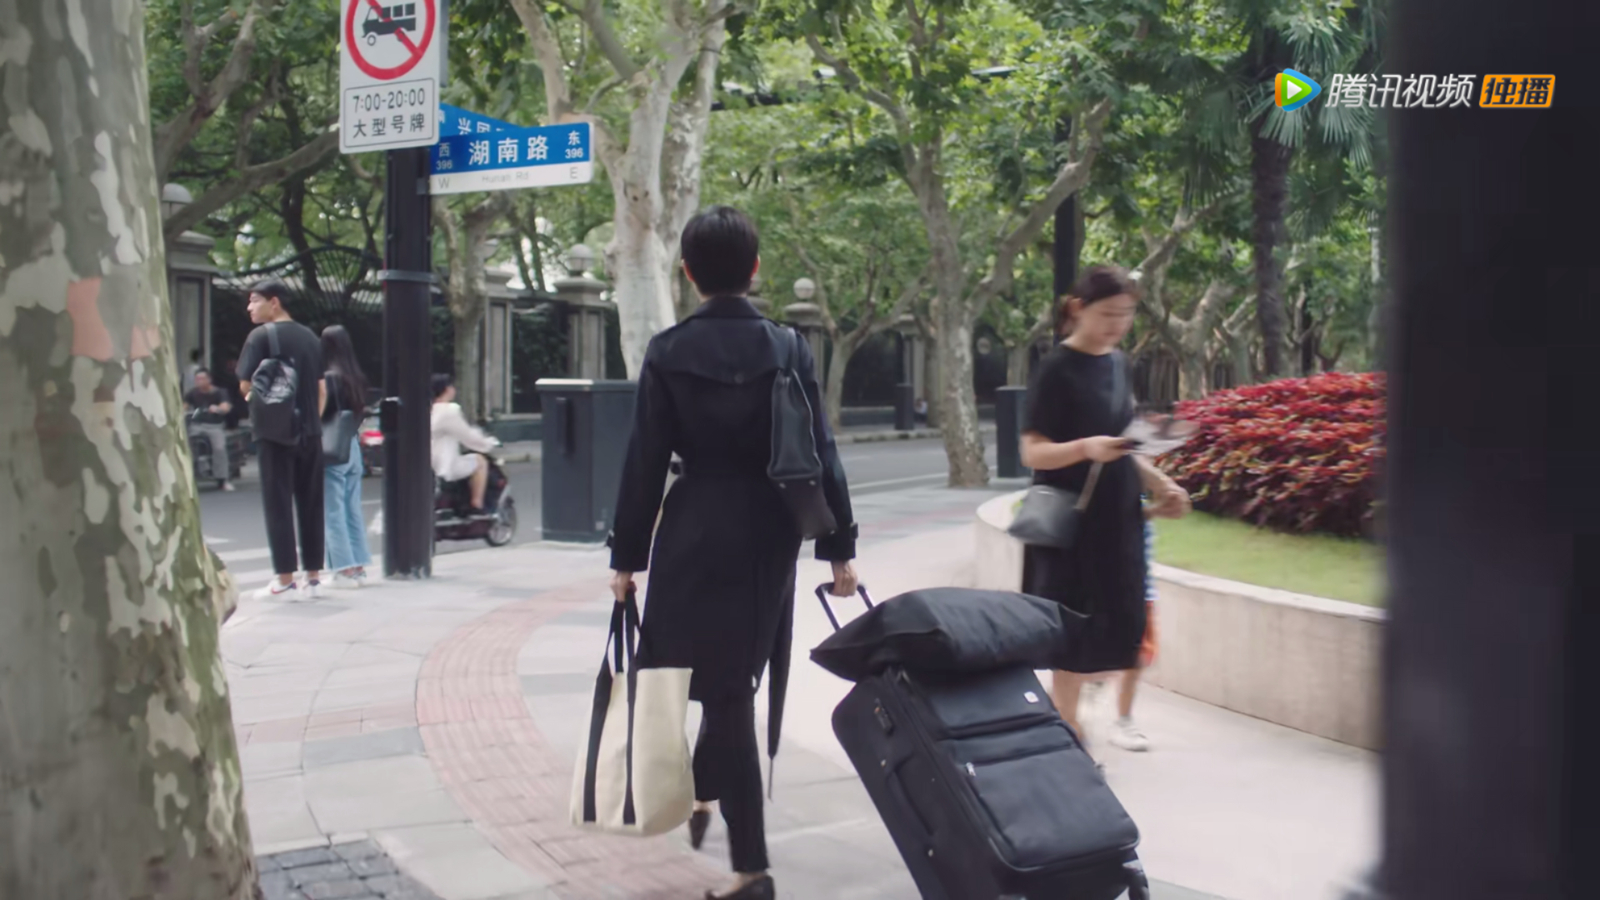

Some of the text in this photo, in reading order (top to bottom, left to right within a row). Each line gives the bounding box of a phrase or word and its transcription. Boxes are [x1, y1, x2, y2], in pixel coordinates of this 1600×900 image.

[353, 88, 425, 113] 7:00-20:00
[353, 113, 425, 139] 大型号牌
[457, 117, 505, 135] 兴国
[567, 130, 581, 146] 东
[439, 142, 450, 157] 西
[468, 135, 549, 166] 湖南路
[564, 147, 584, 159] 396
[515, 170, 529, 181] Rd
[569, 167, 579, 179] E
[438, 178, 450, 189] W
